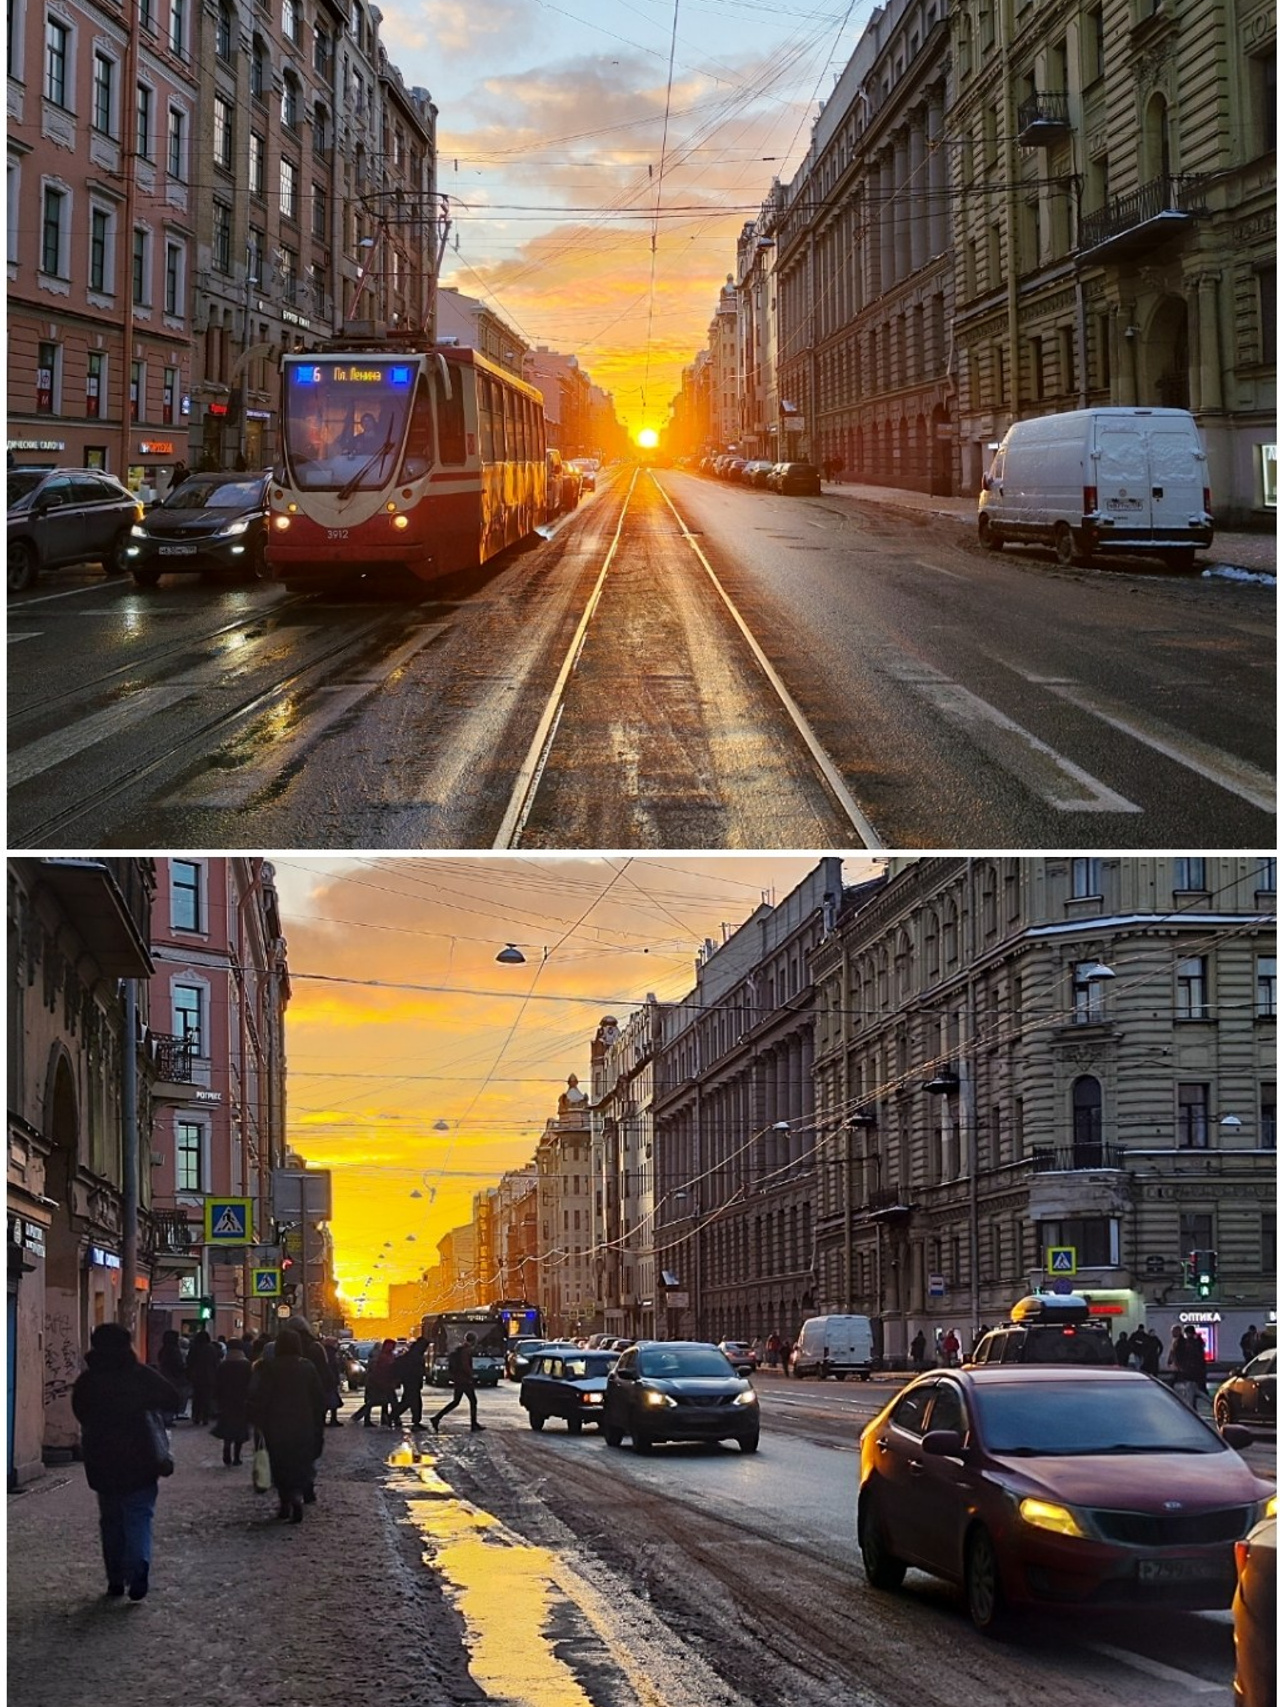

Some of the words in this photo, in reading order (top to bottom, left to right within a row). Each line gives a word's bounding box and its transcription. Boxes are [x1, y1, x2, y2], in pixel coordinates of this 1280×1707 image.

[350, 367, 382, 381] Ленина
[327, 530, 349, 539] 3912
[1179, 1312, 1221, 1322] ОПТИКА
